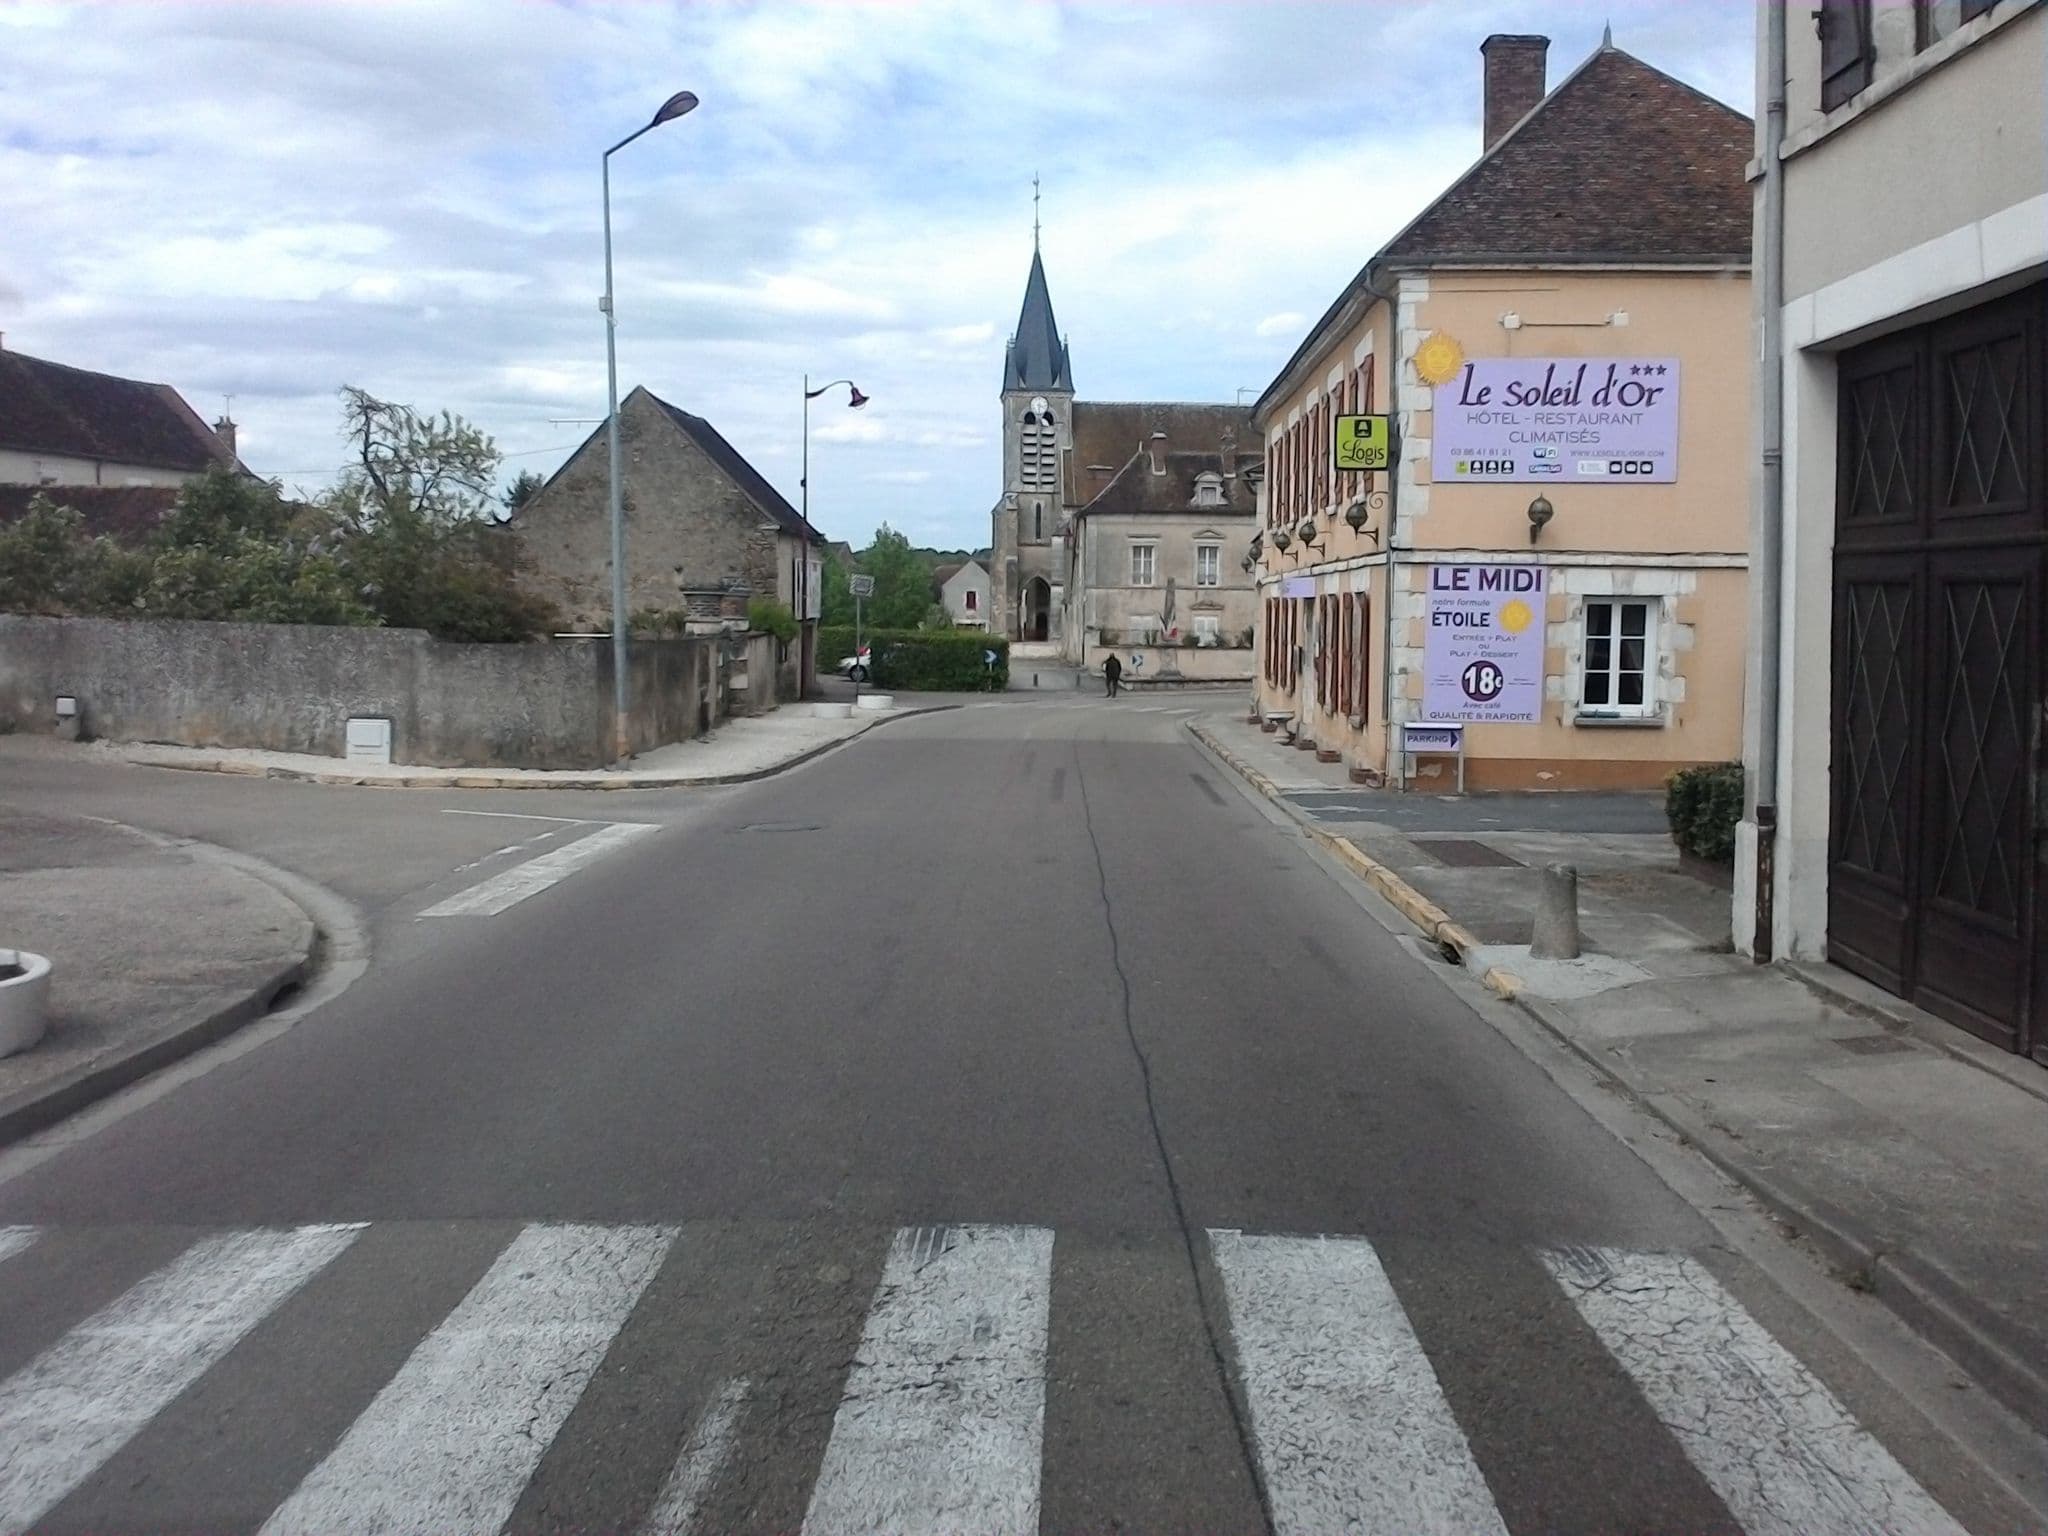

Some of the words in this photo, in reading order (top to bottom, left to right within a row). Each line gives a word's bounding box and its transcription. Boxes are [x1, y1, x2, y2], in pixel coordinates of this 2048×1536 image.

[1458, 363, 1492, 406] Le
[1501, 363, 1588, 408] Soleil
[1591, 363, 1665, 408] d'Or
[1467, 410, 1520, 425] HÔTEL
[1534, 413, 1644, 425] RESTAURANT
[1508, 430, 1601, 444] CLIMATISÉS
[1340, 439, 1385, 466] Logis
[1433, 567, 1471, 591] LE
[1478, 568, 1543, 592] MIDI
[1457, 598, 1490, 608] formule
[1432, 606, 1491, 627] ÉTOILE
[1429, 711, 1473, 720] QUALITÉ
[1485, 711, 1534, 721] RAPIDITÉ
[1407, 735, 1449, 743] PARKING
